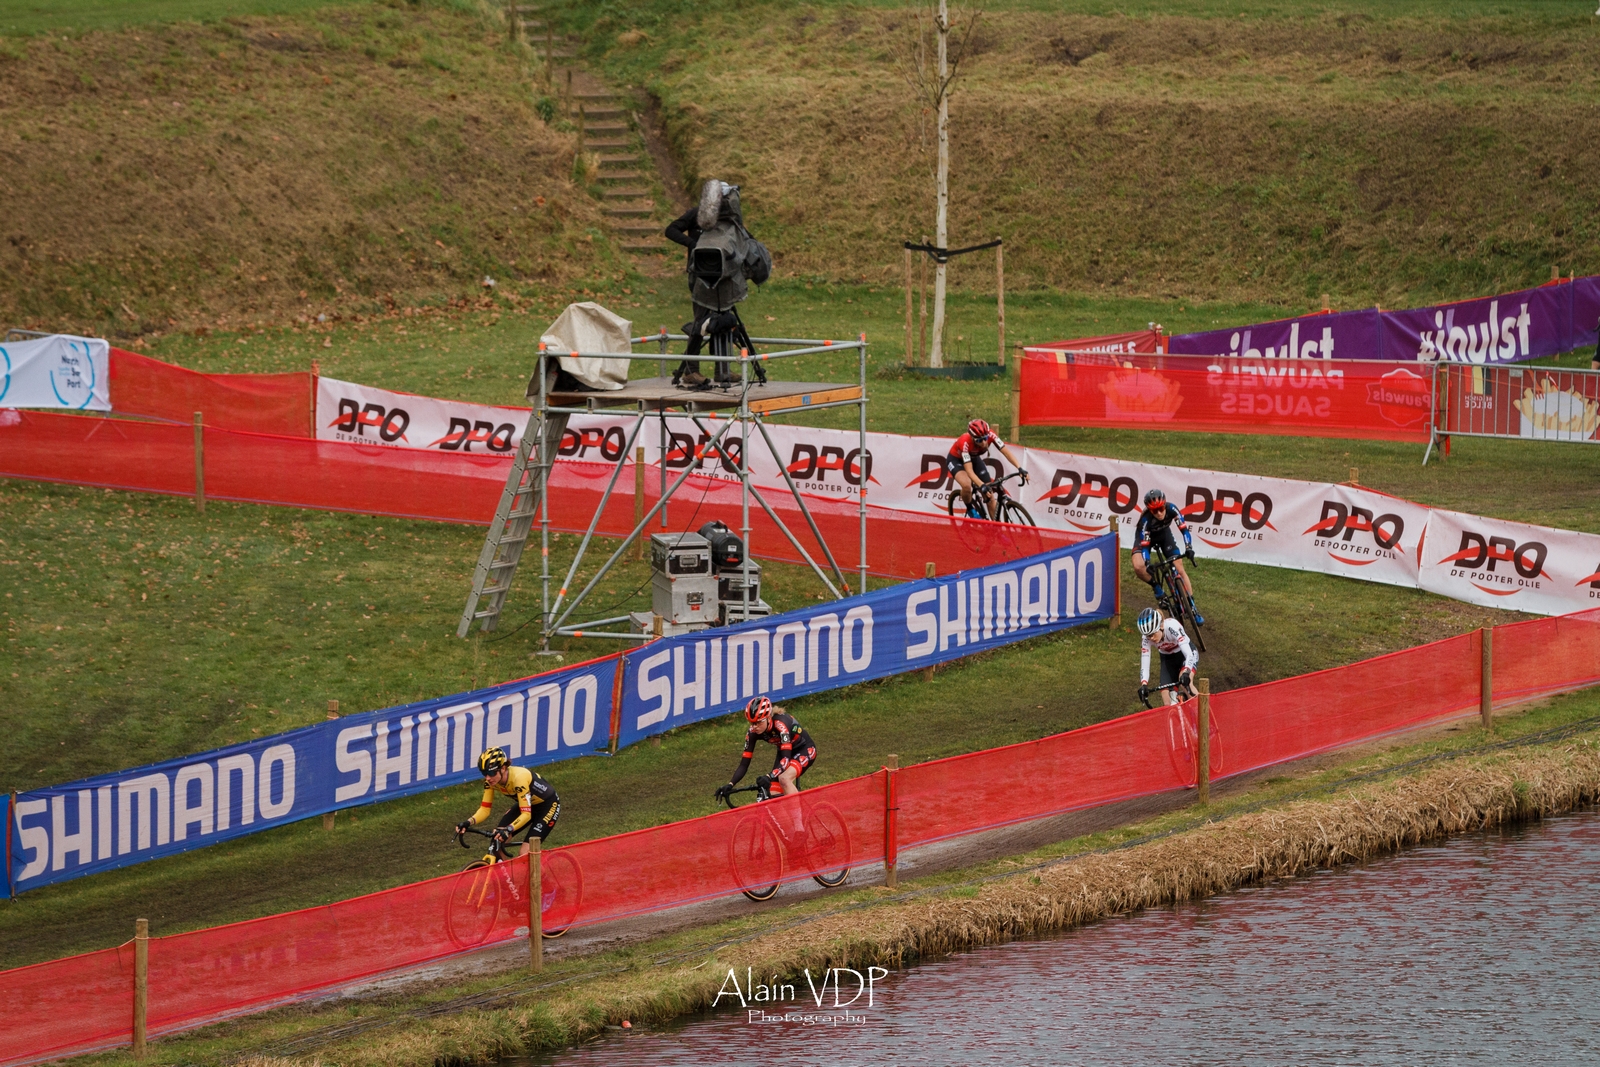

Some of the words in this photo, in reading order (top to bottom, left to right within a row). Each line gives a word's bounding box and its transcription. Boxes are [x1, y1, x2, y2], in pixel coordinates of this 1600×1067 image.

[336, 433, 345, 441] DE
[338, 398, 410, 442] DPO
[439, 417, 516, 452] DPO
[558, 426, 627, 462] DPO
[789, 443, 873, 486] DPO
[805, 483, 842, 492] POOTER
[917, 491, 929, 499] DE
[1049, 469, 1139, 514] DPO
[1048, 506, 1059, 515] DE
[1063, 508, 1103, 521] POOTER
[1184, 485, 1273, 531] DPO
[1316, 500, 1404, 550] DPO
[1198, 526, 1237, 538] POOTER
[1240, 531, 1264, 541] OLIE
[1314, 539, 1326, 548] DE
[1454, 530, 1548, 579] DPO
[1450, 569, 1465, 577] DE
[1470, 572, 1513, 585] POOTER
[1518, 579, 1541, 589] OLIE
[906, 547, 1103, 661] SHIMANO
[637, 604, 874, 731] SHIMANO
[335, 674, 598, 803] SHIMANO
[16, 743, 296, 882] SHIMANO
[542, 801, 558, 824] JUMBO
